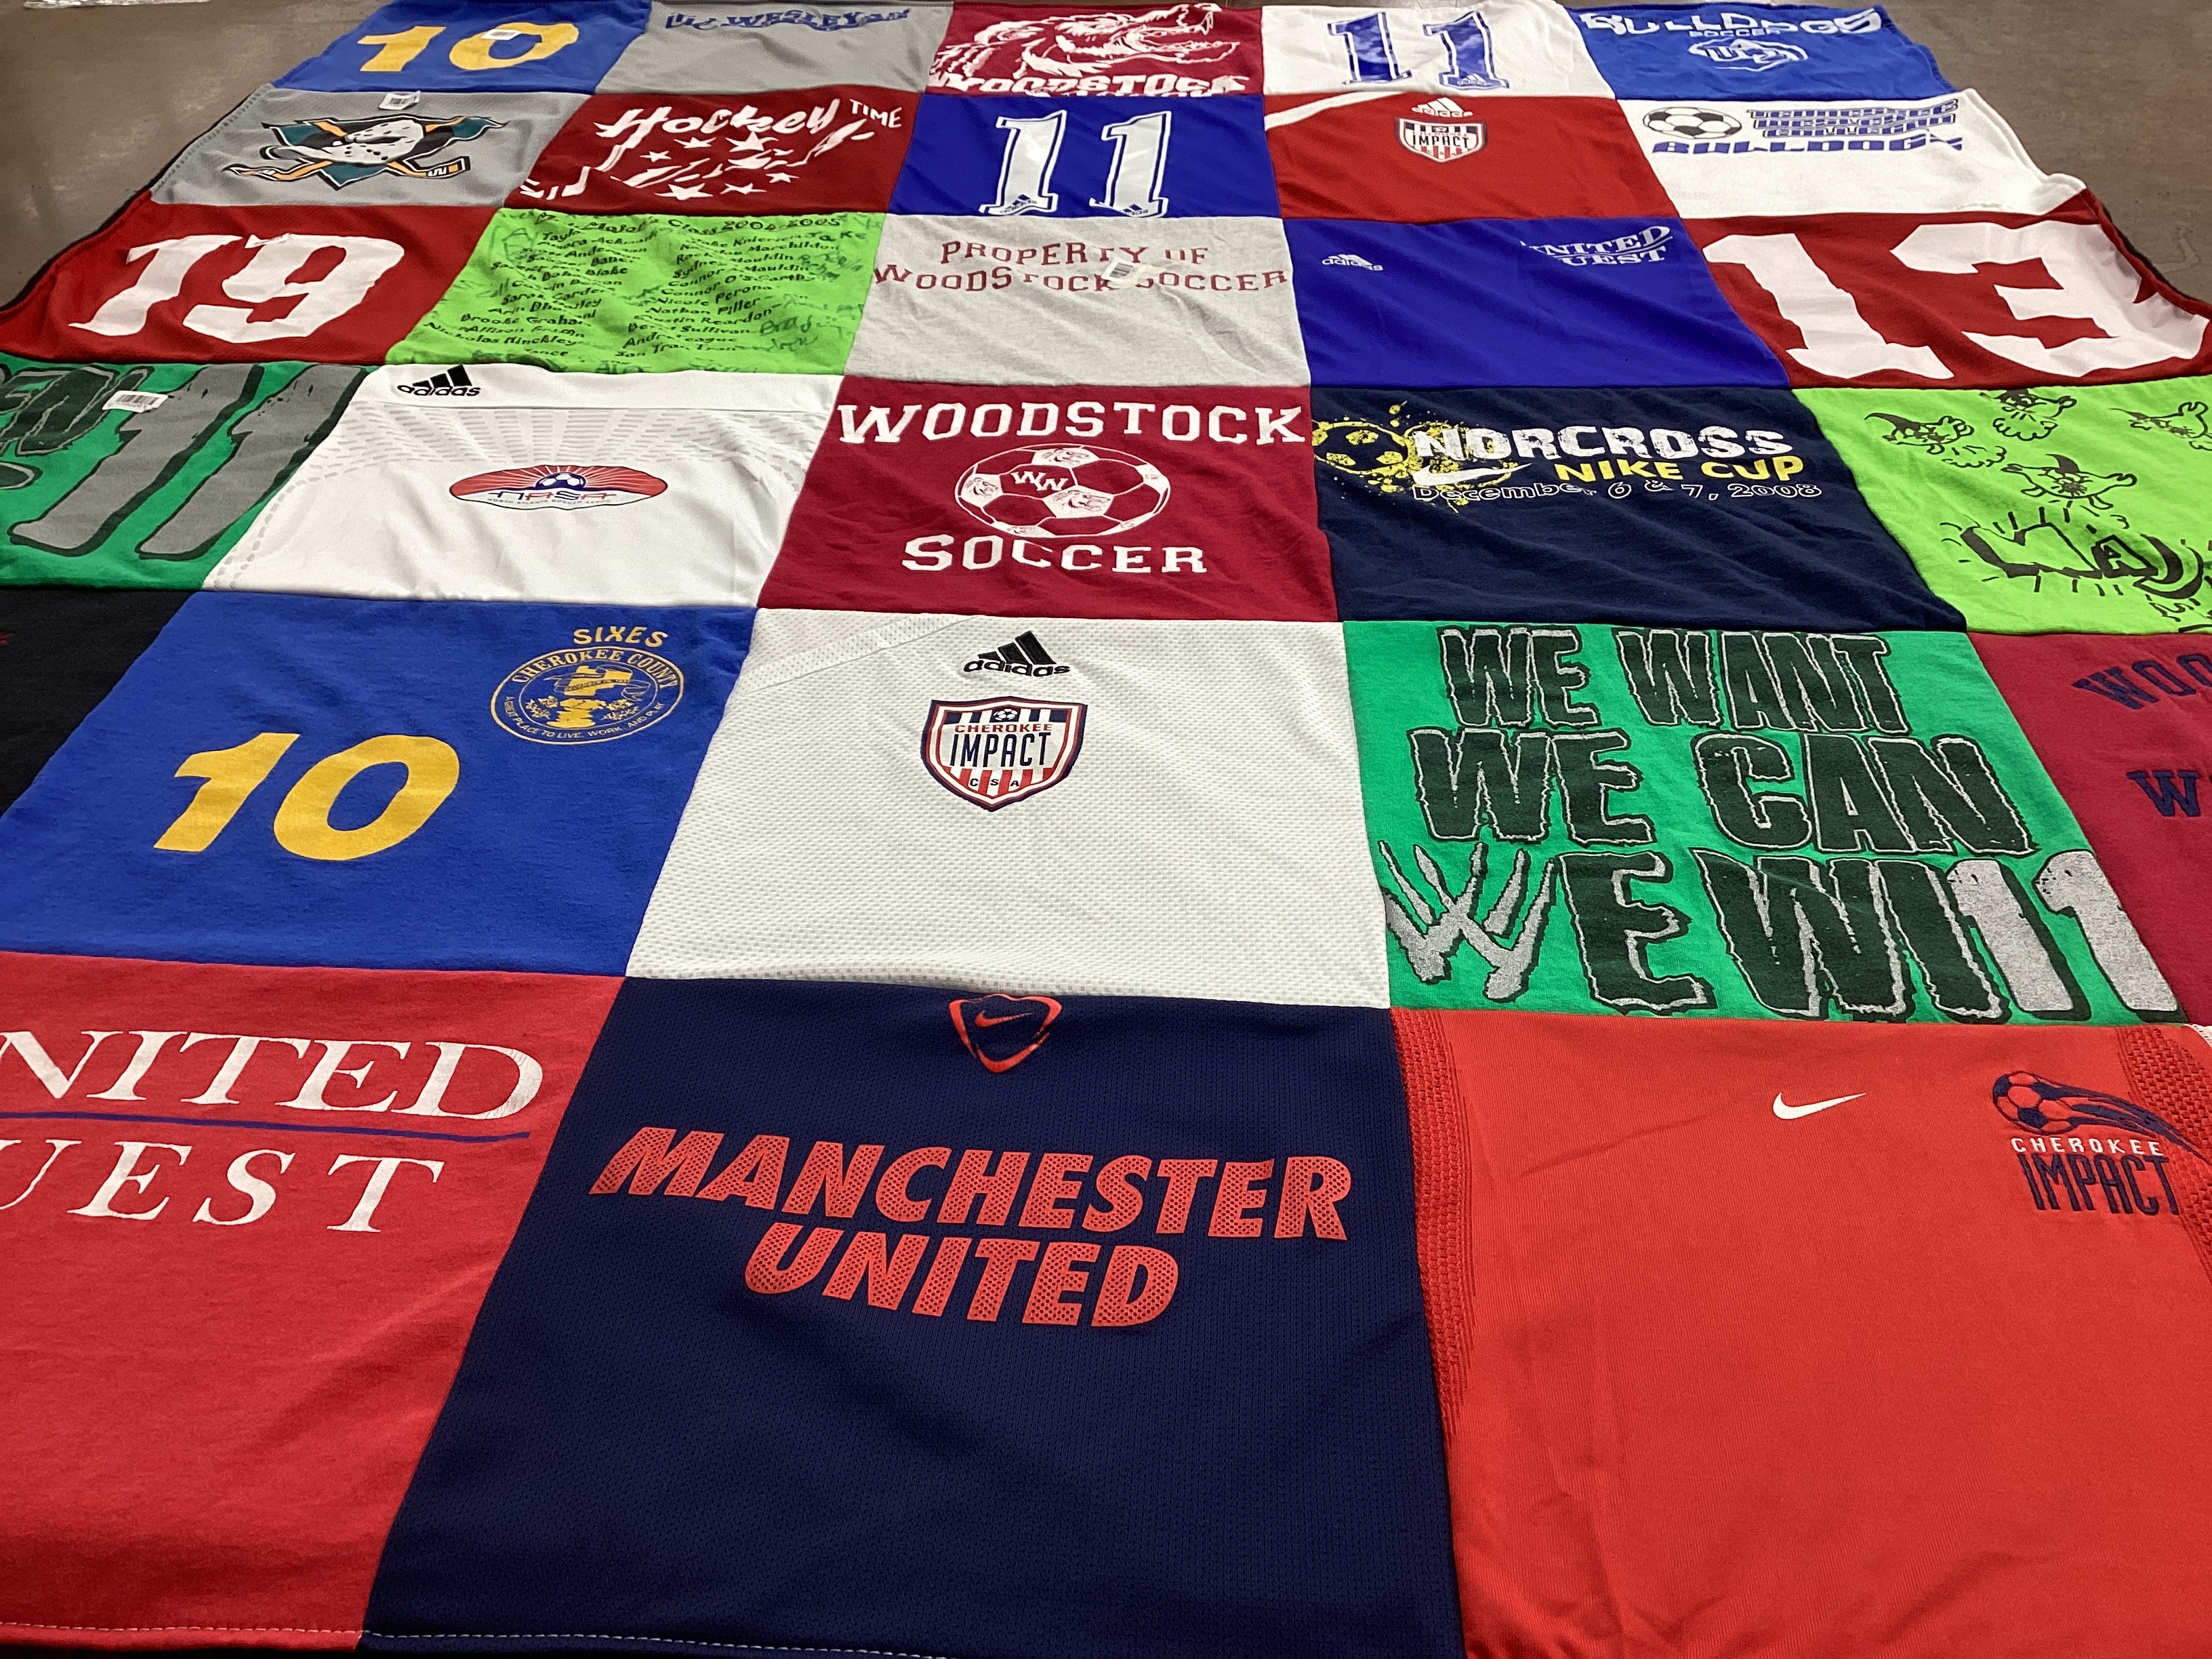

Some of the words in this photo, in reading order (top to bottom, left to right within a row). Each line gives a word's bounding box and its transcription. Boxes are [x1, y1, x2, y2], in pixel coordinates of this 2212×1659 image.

[357, 22, 579, 72] 10
[1327, 11, 1510, 90] 11
[849, 98, 902, 128] TIME
[1412, 136, 1470, 148] IMPACT
[979, 109, 1172, 218] 11
[940, 241, 1149, 265] PROPERTY
[1519, 226, 1671, 256] NITED
[68, 233, 405, 344] 19
[874, 264, 1115, 292] WOODSTOCK
[657, 296, 710, 306] Nicole
[1702, 220, 2210, 380] 13
[396, 384, 481, 396] adidas
[837, 401, 1306, 446] WOODSTOCK
[1411, 425, 1796, 461] NORCROSS
[1555, 457, 1685, 482] NIKE
[1700, 455, 1807, 481] CUP
[1412, 481, 1597, 501] December
[1607, 481, 1633, 499] 6
[1644, 477, 1675, 492] &
[1726, 482, 1824, 499] 2008
[901, 533, 1208, 573] SOCCER
[573, 626, 669, 648] SIXES
[511, 648, 625, 684] CHEROKEE
[963, 659, 1071, 678] adidas
[1438, 625, 1602, 731] WE
[1614, 629, 1912, 736] WANT
[954, 723, 1053, 733] CHEROKEE
[949, 732, 1051, 768] IMPACT
[152, 732, 460, 861] 10
[1408, 727, 1654, 846] WE
[1694, 733, 2039, 856] CAN
[1378, 841, 1717, 1018] WE
[2010, 1137, 2165, 1155] CHEROKEE
[588, 1126, 1352, 1241] MANCHESTER
[2017, 1152, 2181, 1217] IMPACT
[745, 1222, 1179, 1328] UNITED
